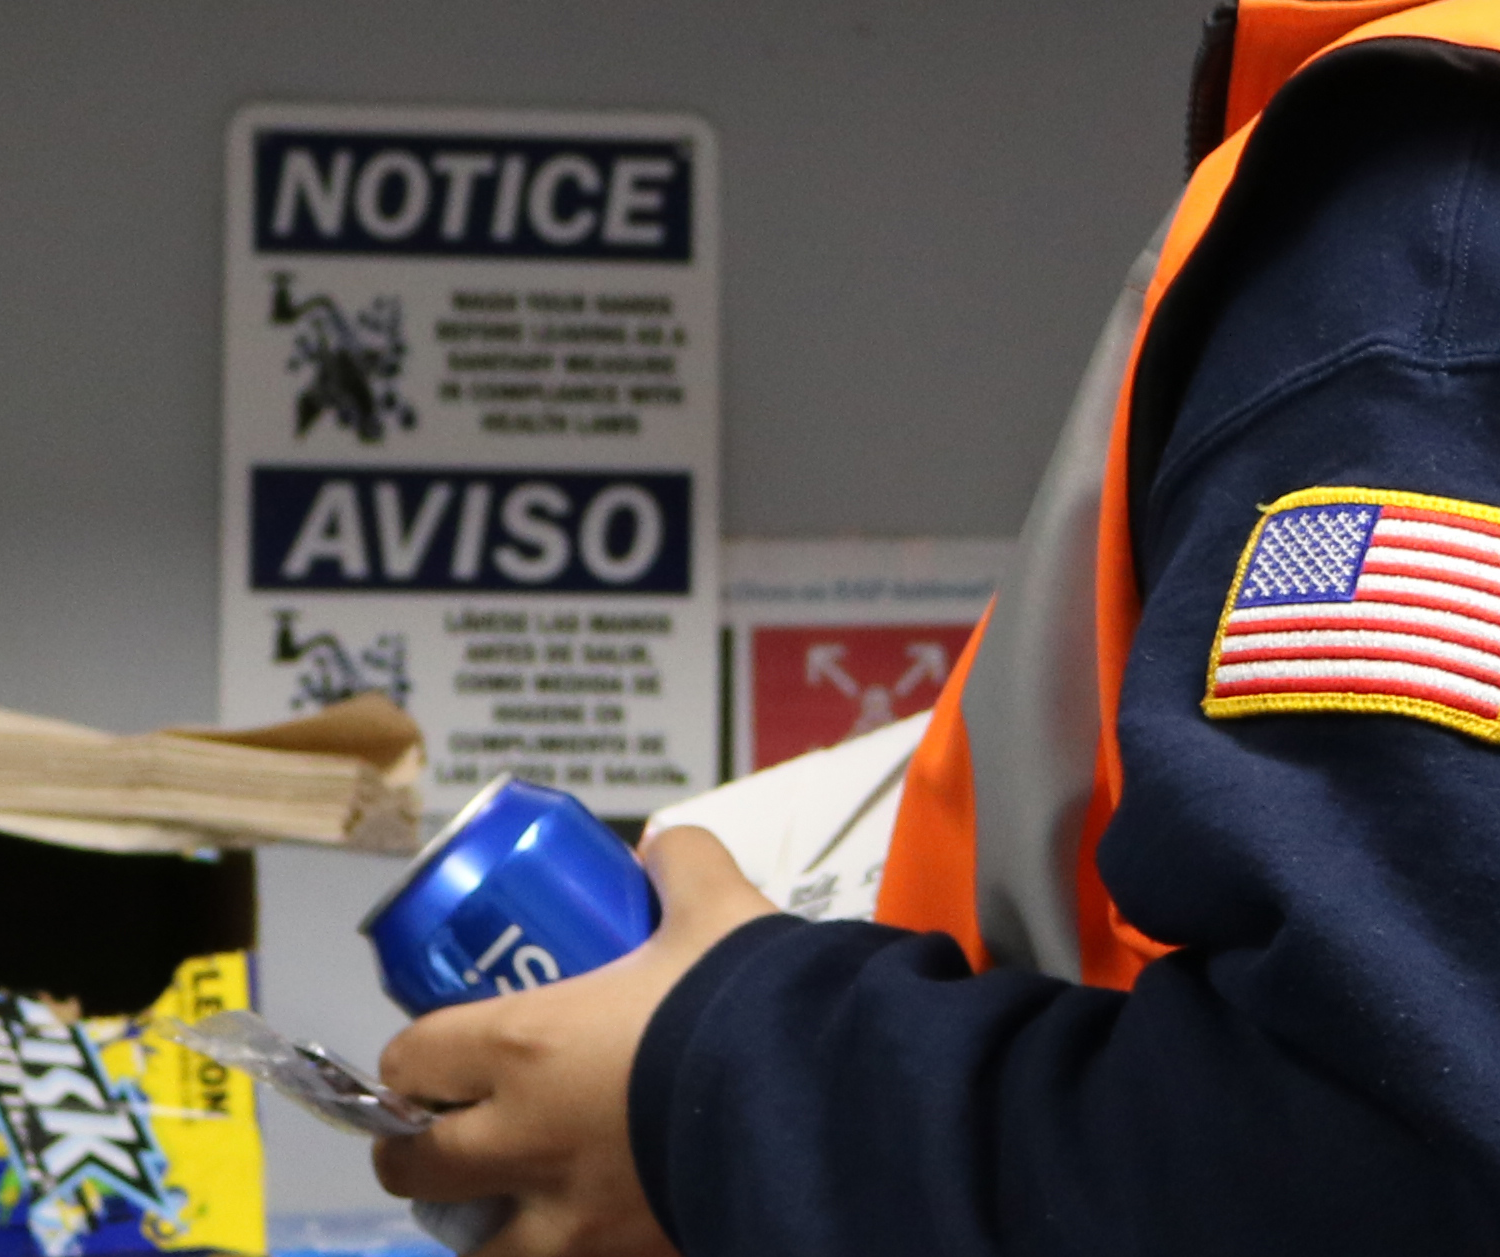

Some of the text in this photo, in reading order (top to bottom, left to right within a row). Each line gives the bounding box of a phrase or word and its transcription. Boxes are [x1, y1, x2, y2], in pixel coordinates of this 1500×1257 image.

[272, 151, 676, 243] NOTICE
[281, 482, 663, 582] AVISO
[191, 970, 229, 1117] LEON
